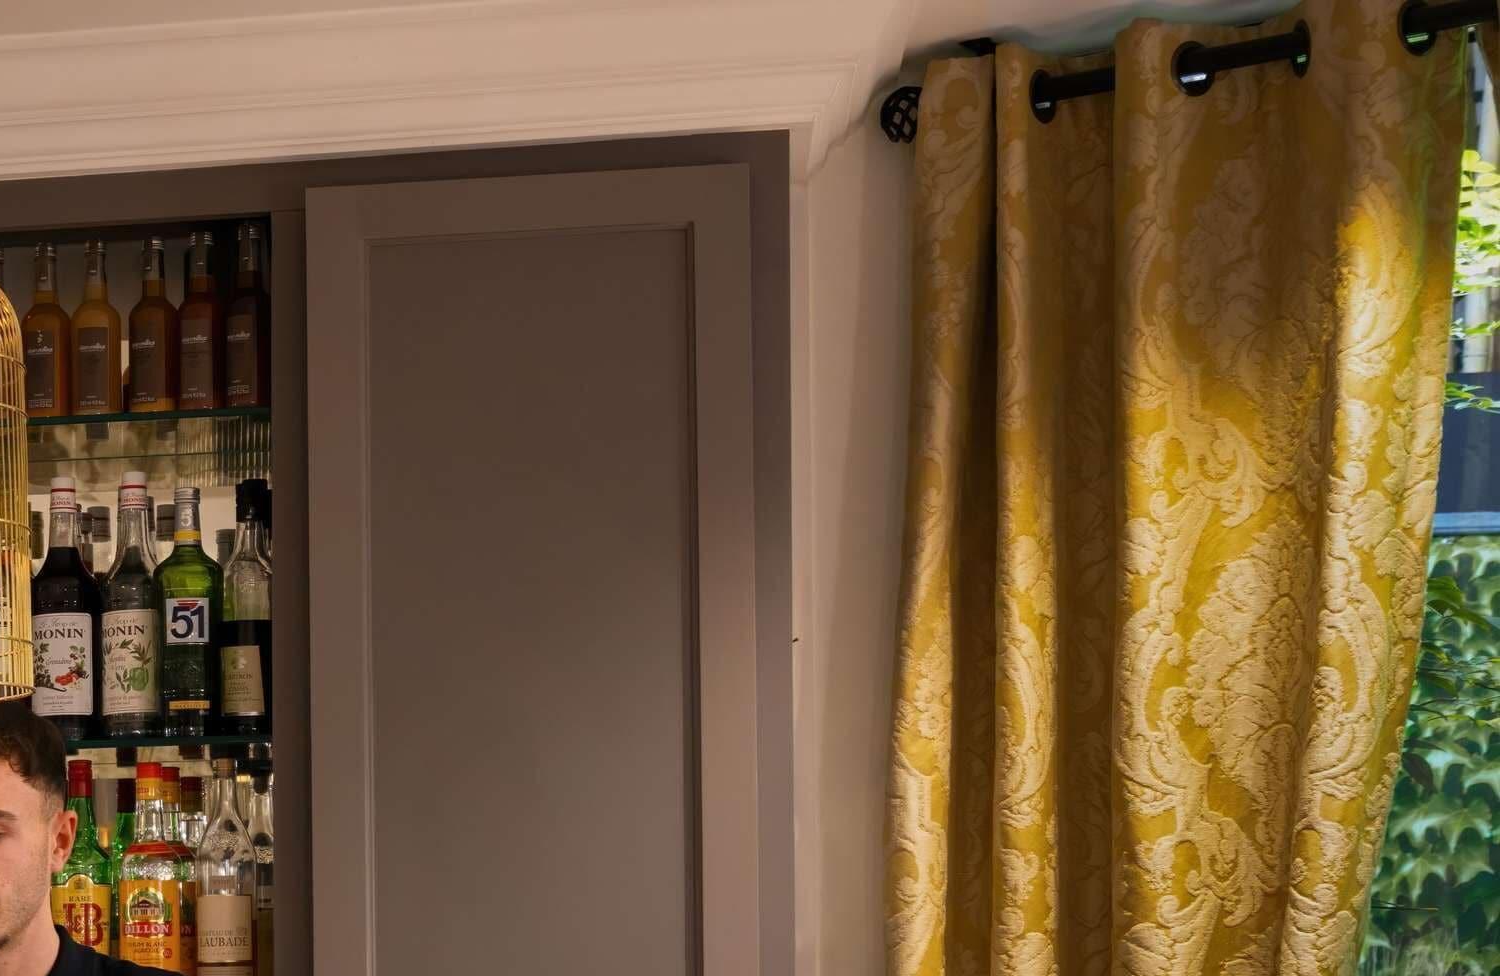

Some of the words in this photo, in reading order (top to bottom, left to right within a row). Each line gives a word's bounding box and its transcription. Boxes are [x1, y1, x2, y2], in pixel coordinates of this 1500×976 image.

[170, 604, 205, 639] 51
[34, 628, 84, 640] MONIN
[124, 924, 169, 935] DILLON
[200, 936, 249, 947] LAUBADE
